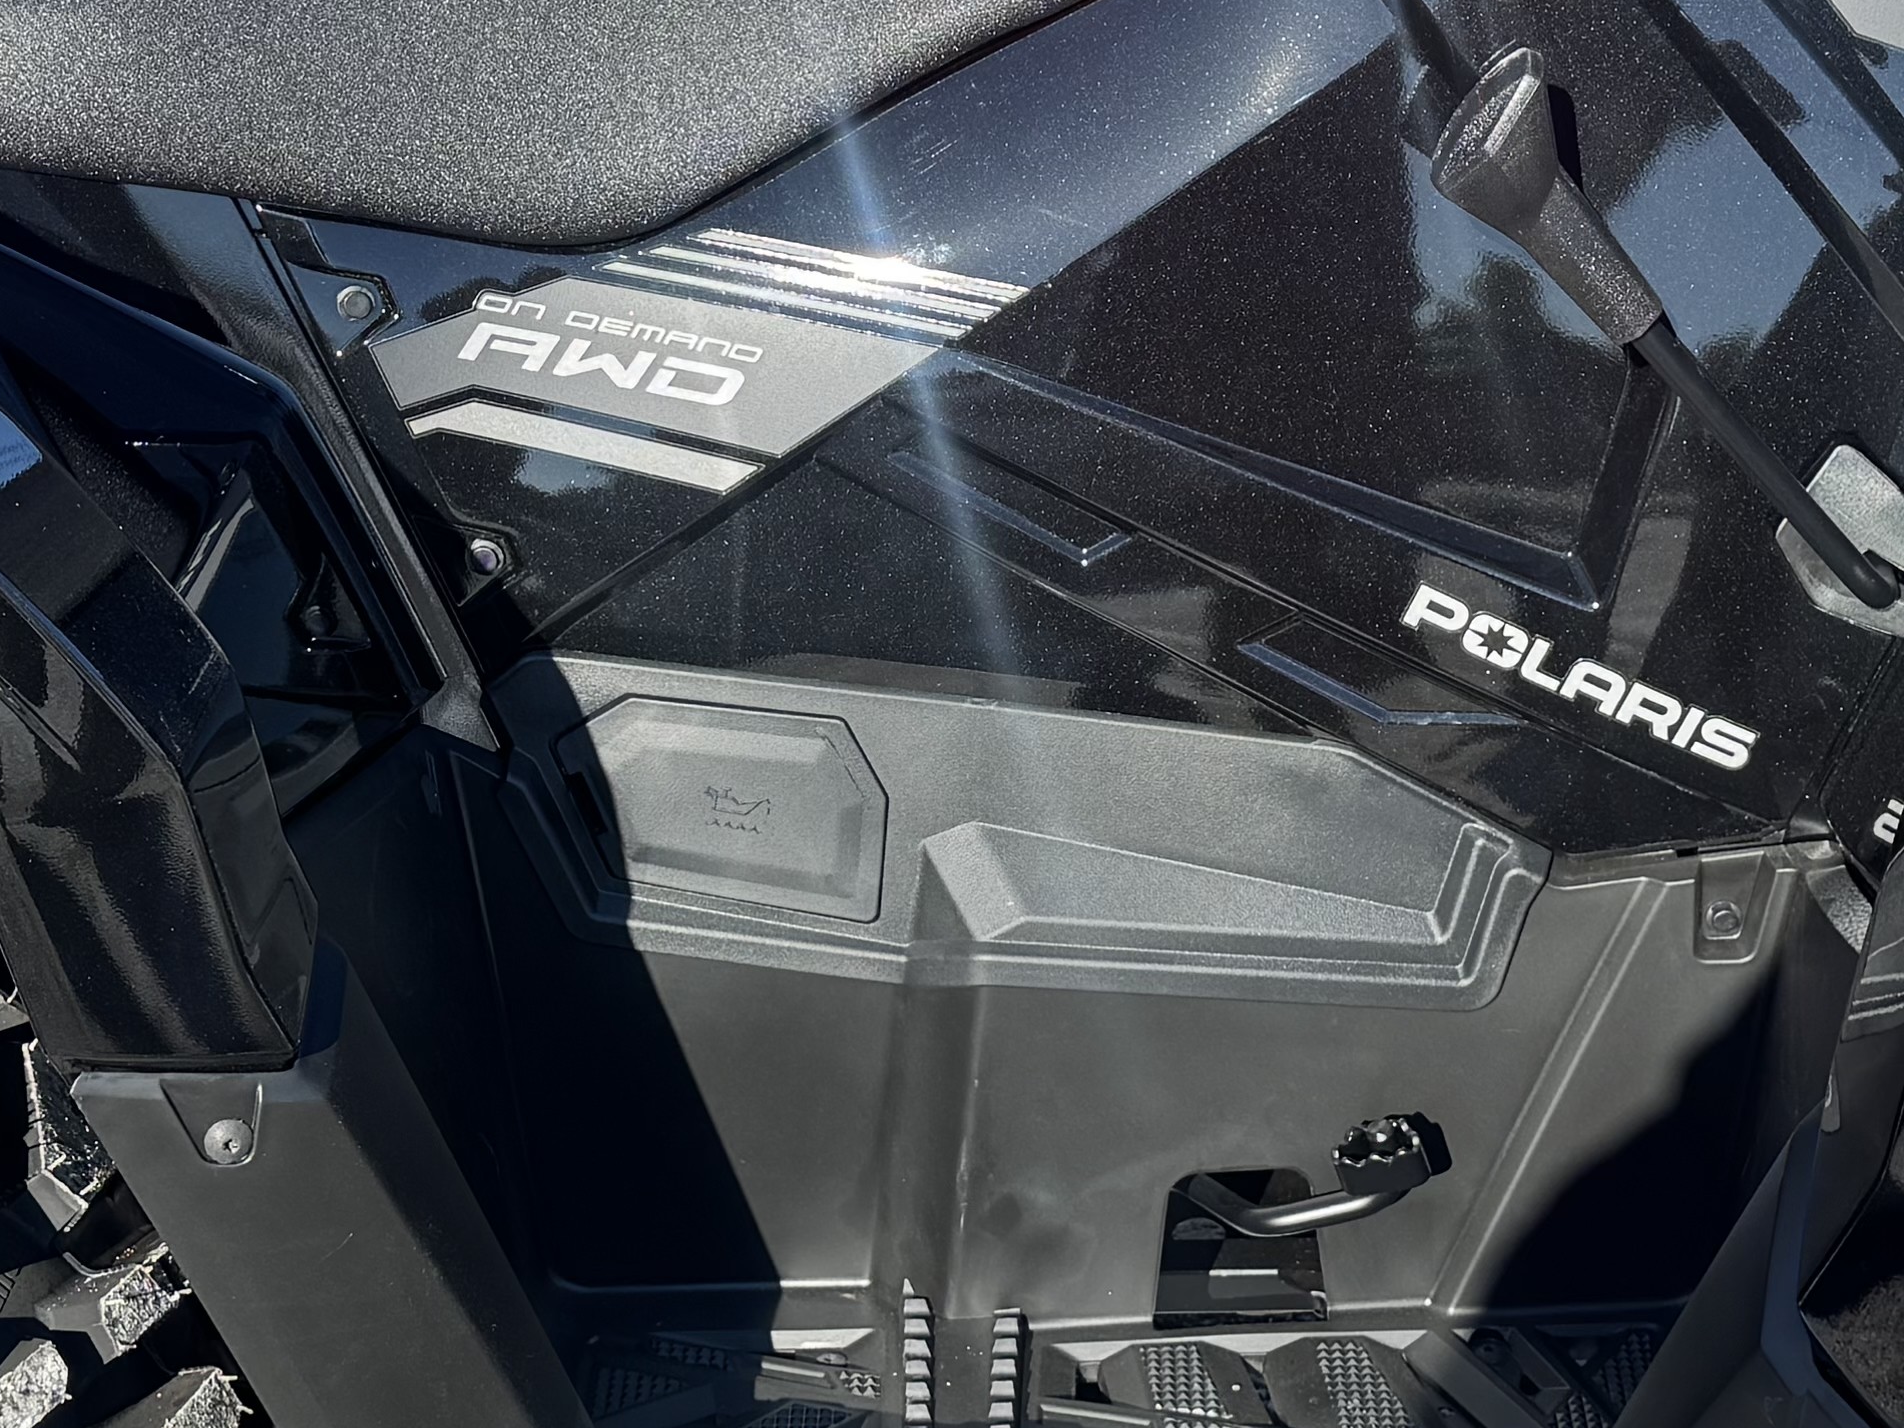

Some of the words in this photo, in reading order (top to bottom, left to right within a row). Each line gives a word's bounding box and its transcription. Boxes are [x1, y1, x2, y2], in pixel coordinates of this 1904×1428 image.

[456, 321, 746, 407] AWD
[475, 293, 547, 320] ON
[564, 309, 765, 364] DEMAND
[1399, 579, 1761, 771] POLARIS
